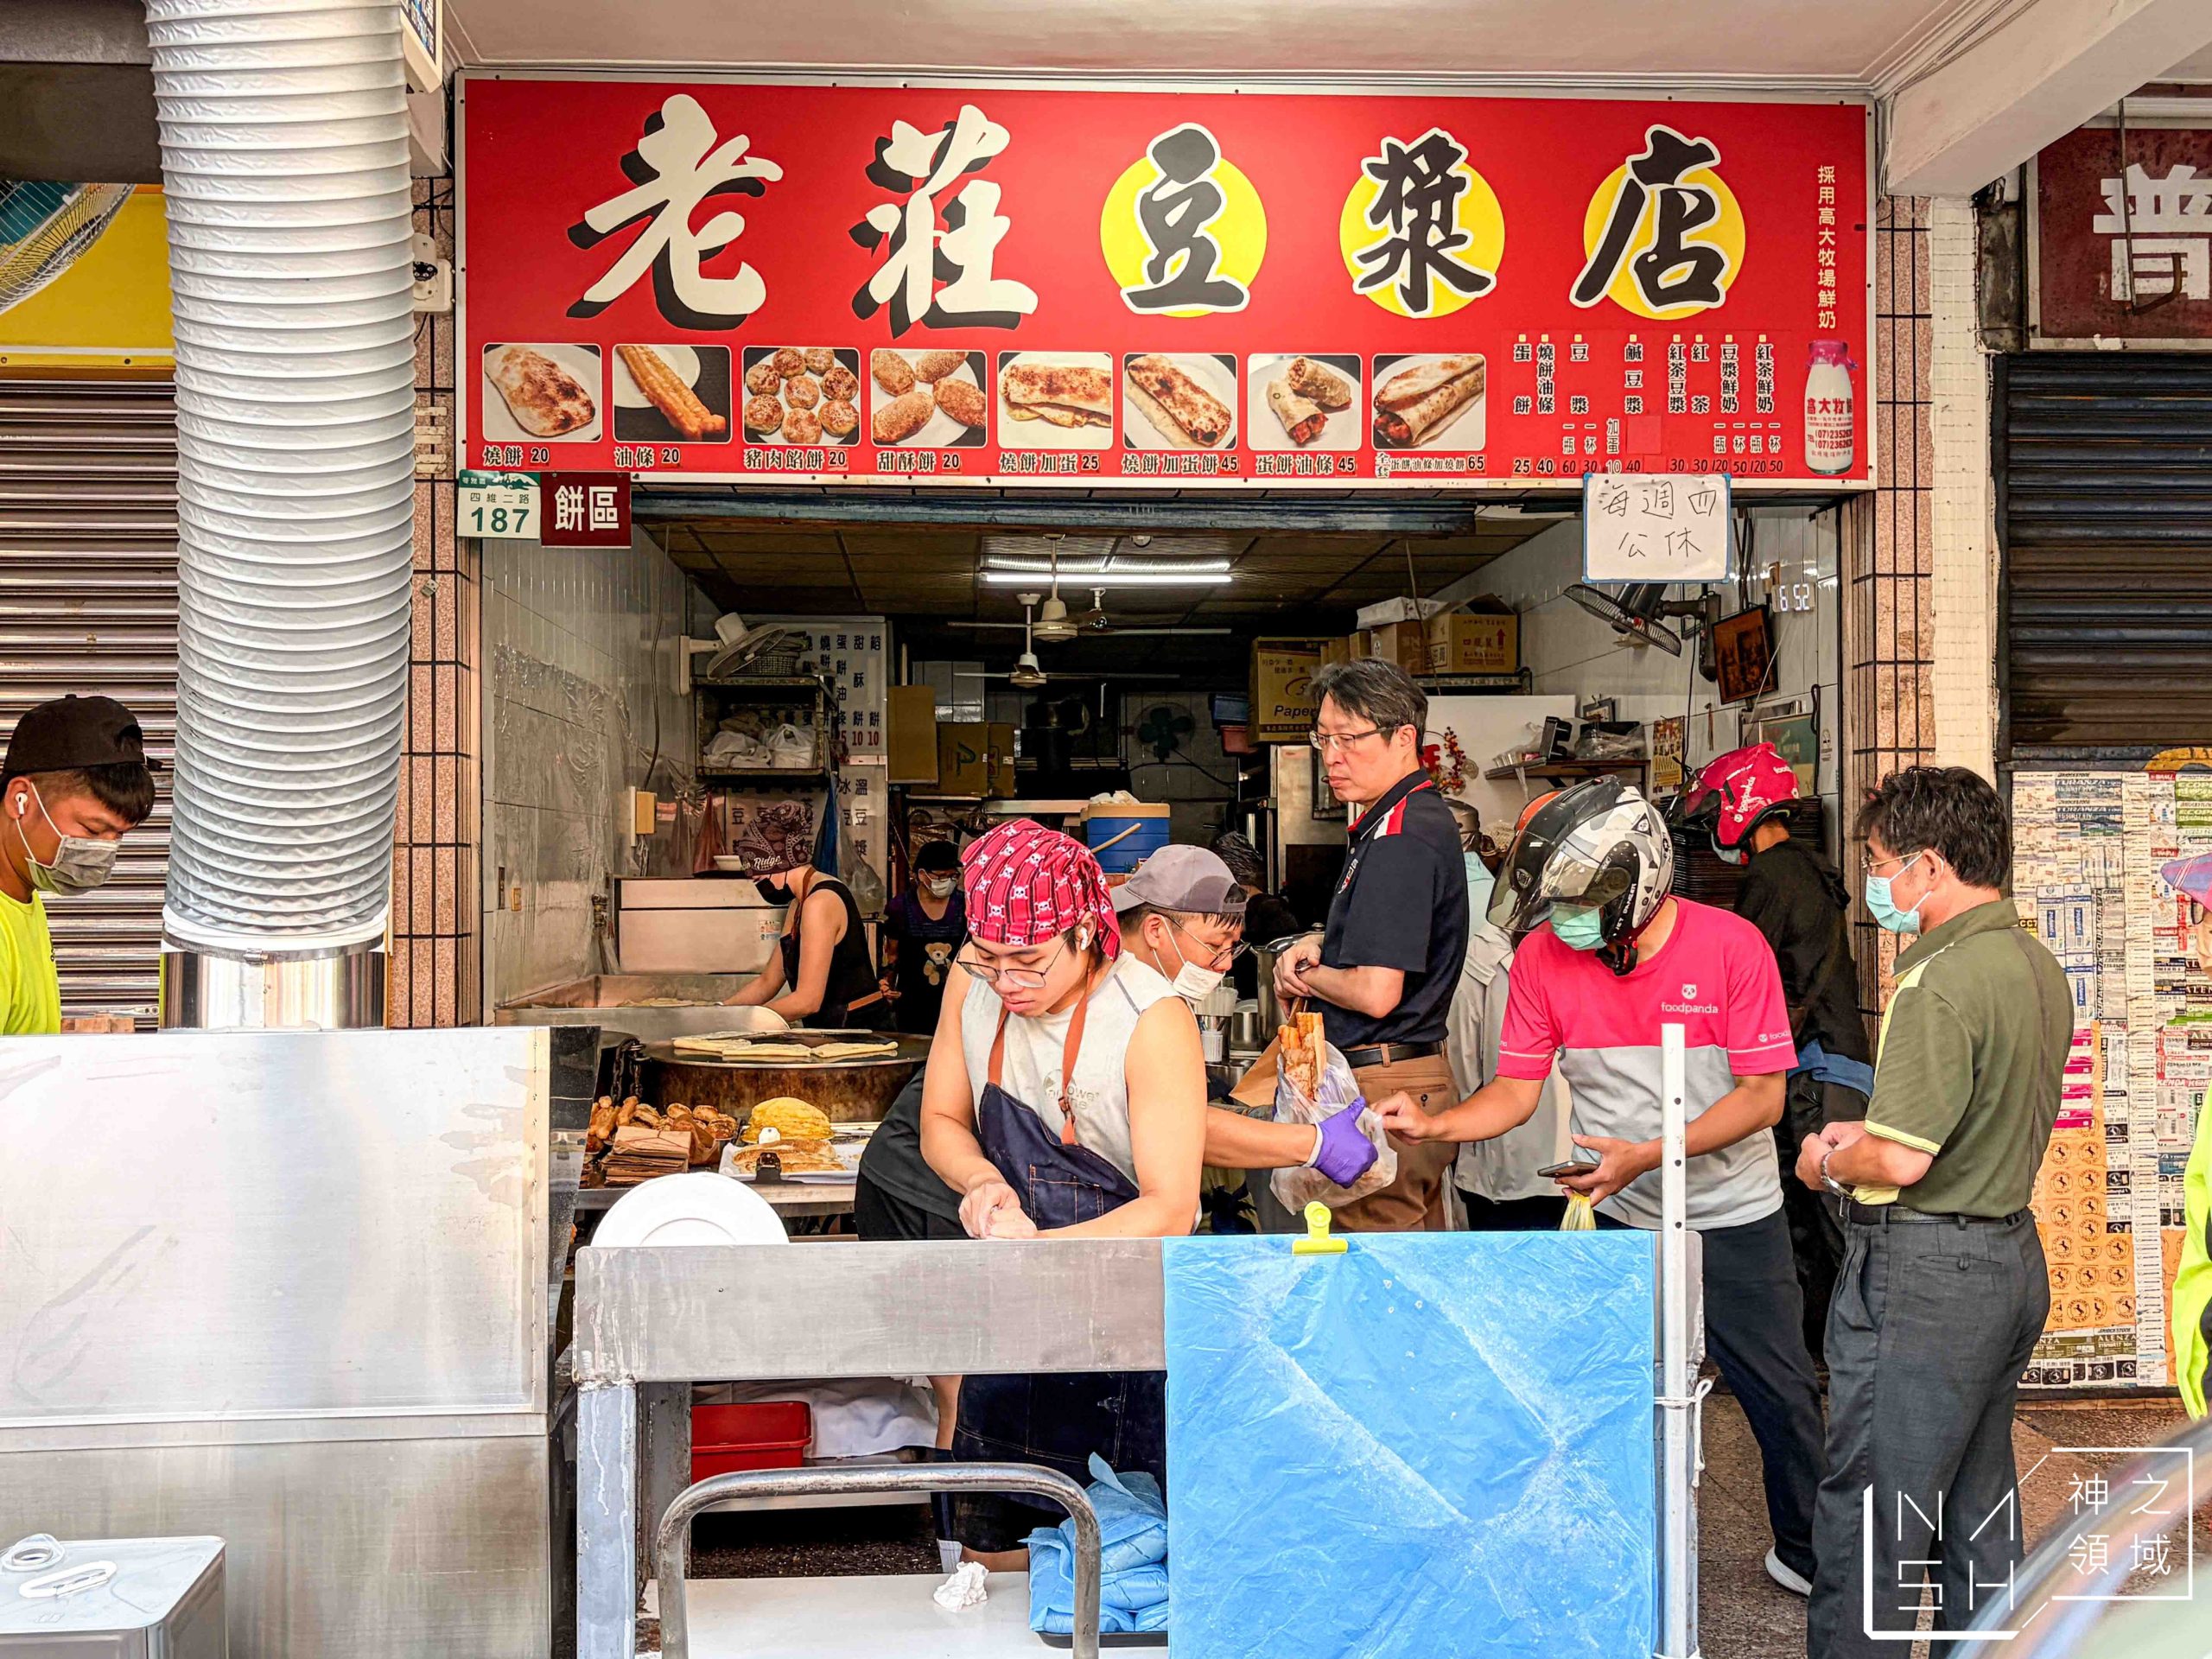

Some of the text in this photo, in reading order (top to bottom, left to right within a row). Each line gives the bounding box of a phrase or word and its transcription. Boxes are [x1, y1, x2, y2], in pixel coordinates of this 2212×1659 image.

[2093, 162, 2212, 300] 普
[1817, 165, 1837, 329] 採用高大牧場鮮奶
[1514, 344, 1531, 413] 蛋餅
[1536, 344, 1554, 413] 燒餅油條
[1570, 344, 1588, 413] 豆漿
[1624, 344, 1642, 413] 鹹豆漿
[1669, 344, 1685, 413] 紅茶豆漿
[1691, 344, 1709, 413] 紅茶
[1720, 344, 1738, 413] 豆漿鮮奶
[1756, 344, 1773, 413] 紅茶鮮奶
[483, 447, 549, 466] 燒餅 20
[614, 447, 680, 467] 油條 20
[744, 448, 847, 470] 豬肉餡餅 20
[877, 451, 961, 472] 甜酥餅 20
[999, 453, 1098, 473] 燒餅加蛋 25
[1122, 453, 1238, 474] 燒餅加蛋餅 45
[1255, 454, 1355, 474] 蛋餅油條 45
[1468, 455, 1484, 470] 65
[1562, 460, 1576, 473] 60
[1584, 460, 1598, 473] 30
[1626, 460, 1641, 473] 40
[1669, 460, 1684, 473] 30
[1693, 460, 1708, 473] 30
[1712, 460, 1728, 473] 120
[1514, 460, 1531, 474] 25
[1536, 460, 1554, 474] 40
[1605, 460, 1622, 474] 10
[1732, 461, 1747, 474] 50
[1750, 460, 1766, 474] 120
[1769, 460, 1783, 474] 50
[470, 493, 530, 505] 四維二路
[554, 485, 620, 531] 餅區
[1602, 480, 1717, 519] 每週四
[471, 507, 530, 533] 187
[1618, 527, 1702, 558] 公休
[852, 731, 863, 746] 10
[868, 731, 880, 746] 10
[1661, 1002, 1719, 1014] foodpanda
